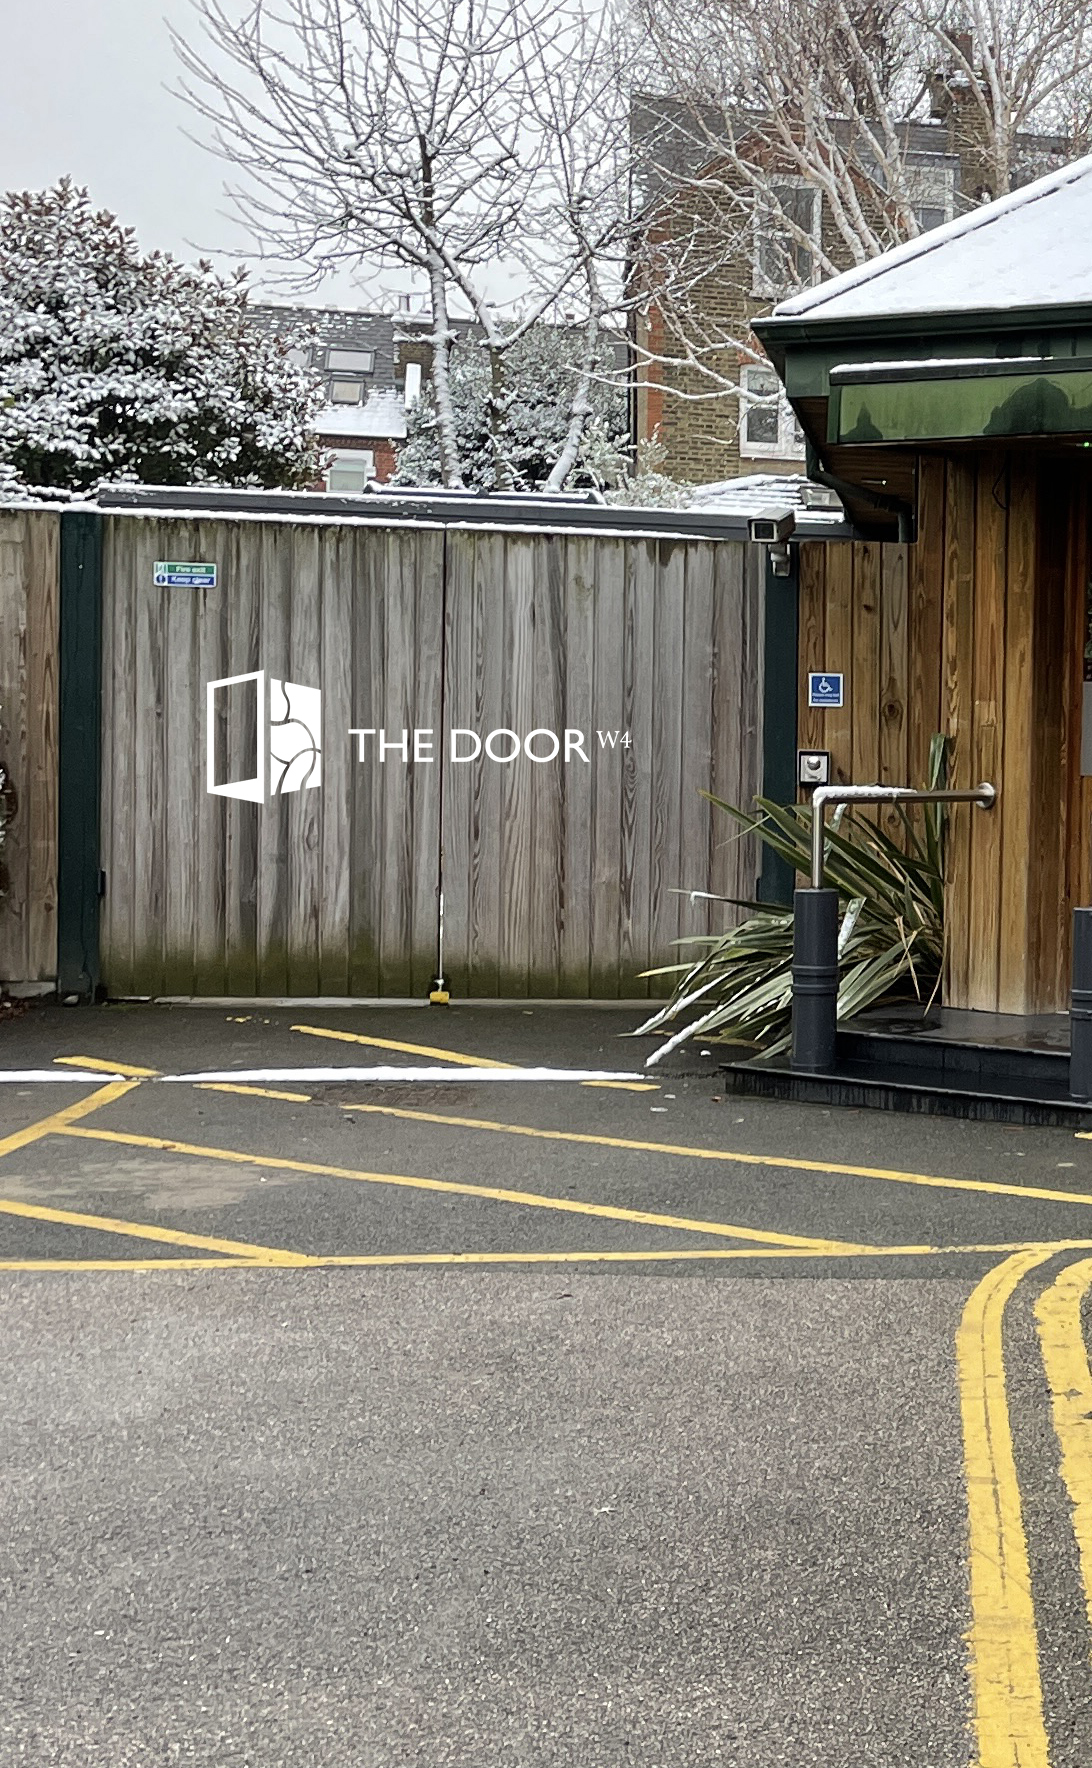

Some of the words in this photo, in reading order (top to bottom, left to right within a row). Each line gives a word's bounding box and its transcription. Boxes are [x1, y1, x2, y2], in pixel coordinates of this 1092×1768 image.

[348, 728, 434, 763] THE
[450, 728, 590, 763] DOOR
[596, 730, 632, 749] W4
